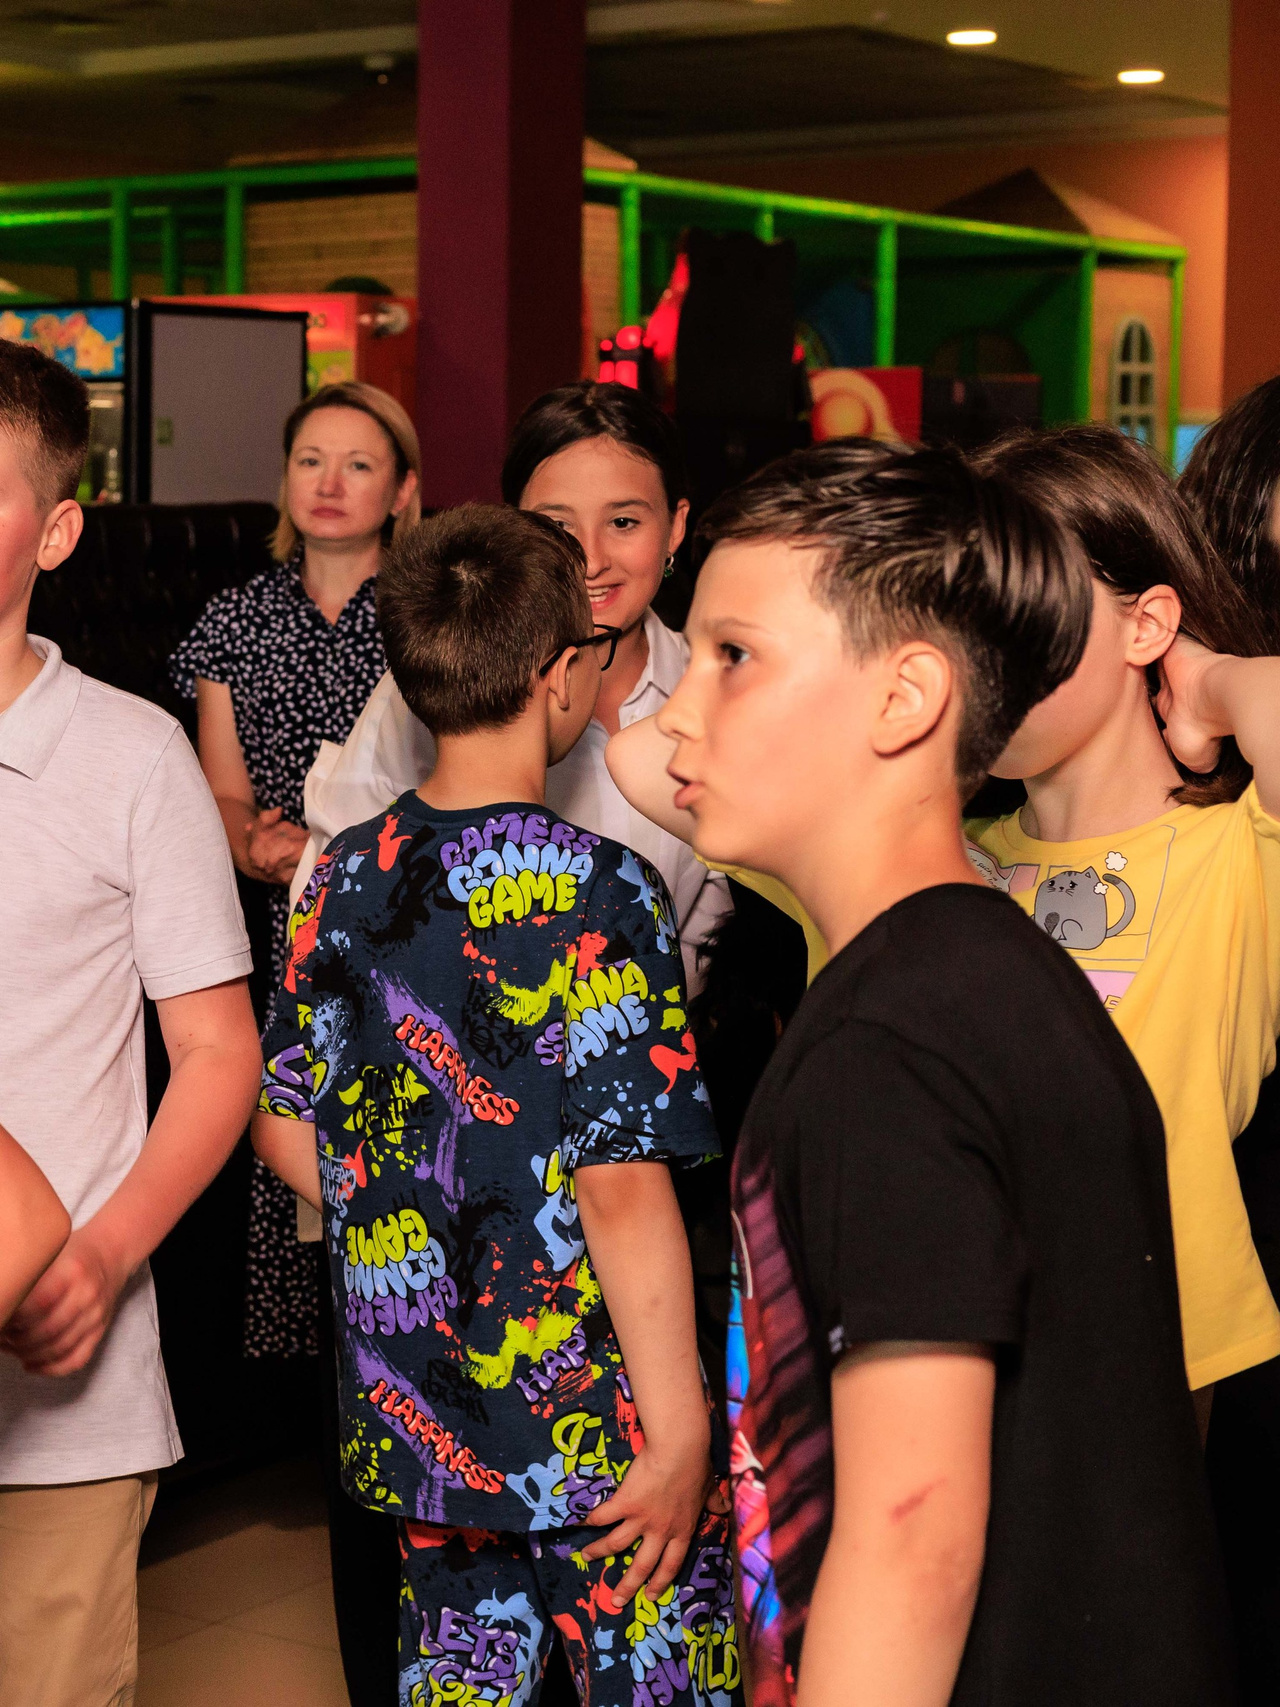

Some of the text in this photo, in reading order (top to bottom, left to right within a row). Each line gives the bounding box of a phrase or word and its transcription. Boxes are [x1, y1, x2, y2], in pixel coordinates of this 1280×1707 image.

[439, 812, 602, 872] GAMERS
[447, 840, 594, 903] GONNA
[468, 868, 578, 929] GAME
[395, 1014, 521, 1126] HAPPINESS
[343, 1236, 447, 1303] GONNA
[346, 1208, 429, 1270] GAME
[345, 1273, 459, 1337] GAMERS
[368, 1379, 506, 1494] HAPPINESS
[419, 1606, 521, 1678] LETS
